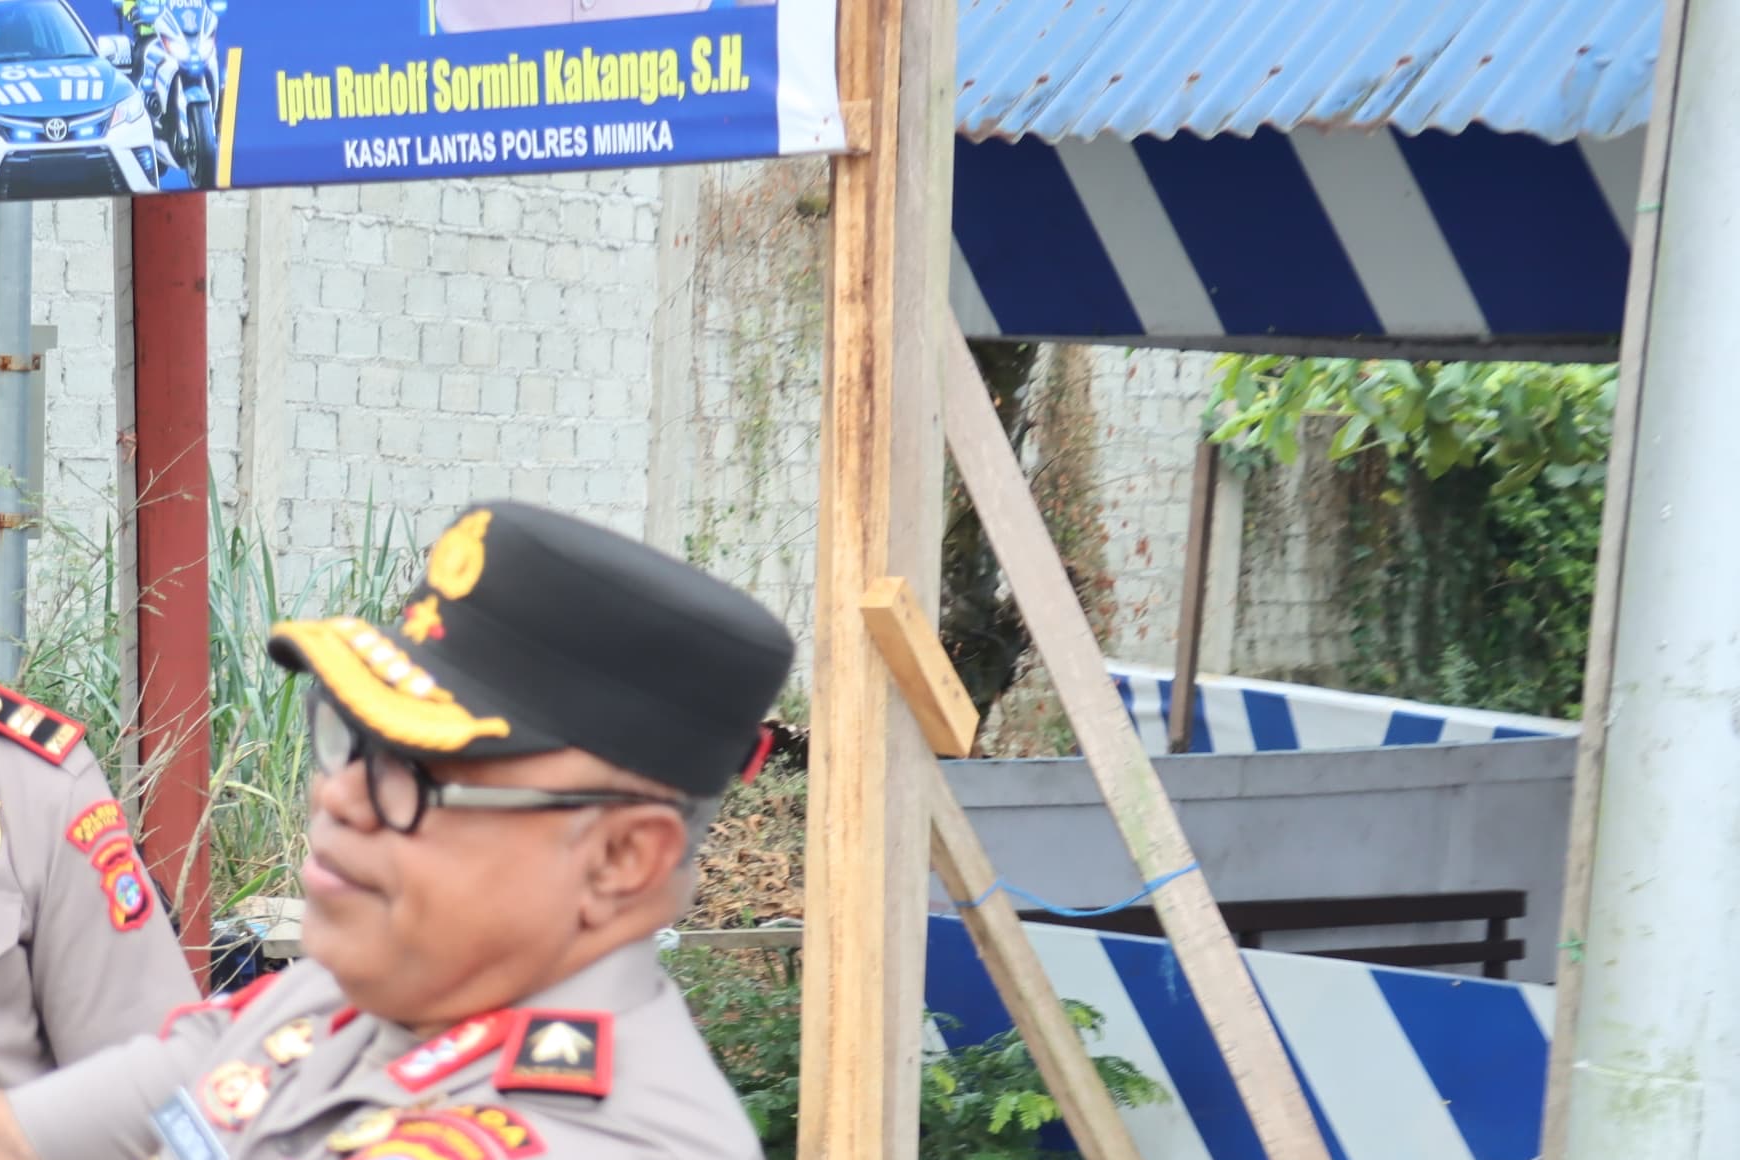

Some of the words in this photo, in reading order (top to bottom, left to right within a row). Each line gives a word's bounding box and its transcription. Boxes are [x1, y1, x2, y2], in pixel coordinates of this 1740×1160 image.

[276, 68, 334, 127] Iptu
[337, 60, 429, 120] Rudolf
[432, 52, 540, 114] Sormin
[544, 42, 685, 108] Kakanga,
[691, 33, 751, 95] S.H.
[343, 132, 412, 169] KASAT
[416, 127, 497, 166] LANTAS
[501, 124, 589, 161] POLRES
[592, 120, 674, 156] MIMIKA
